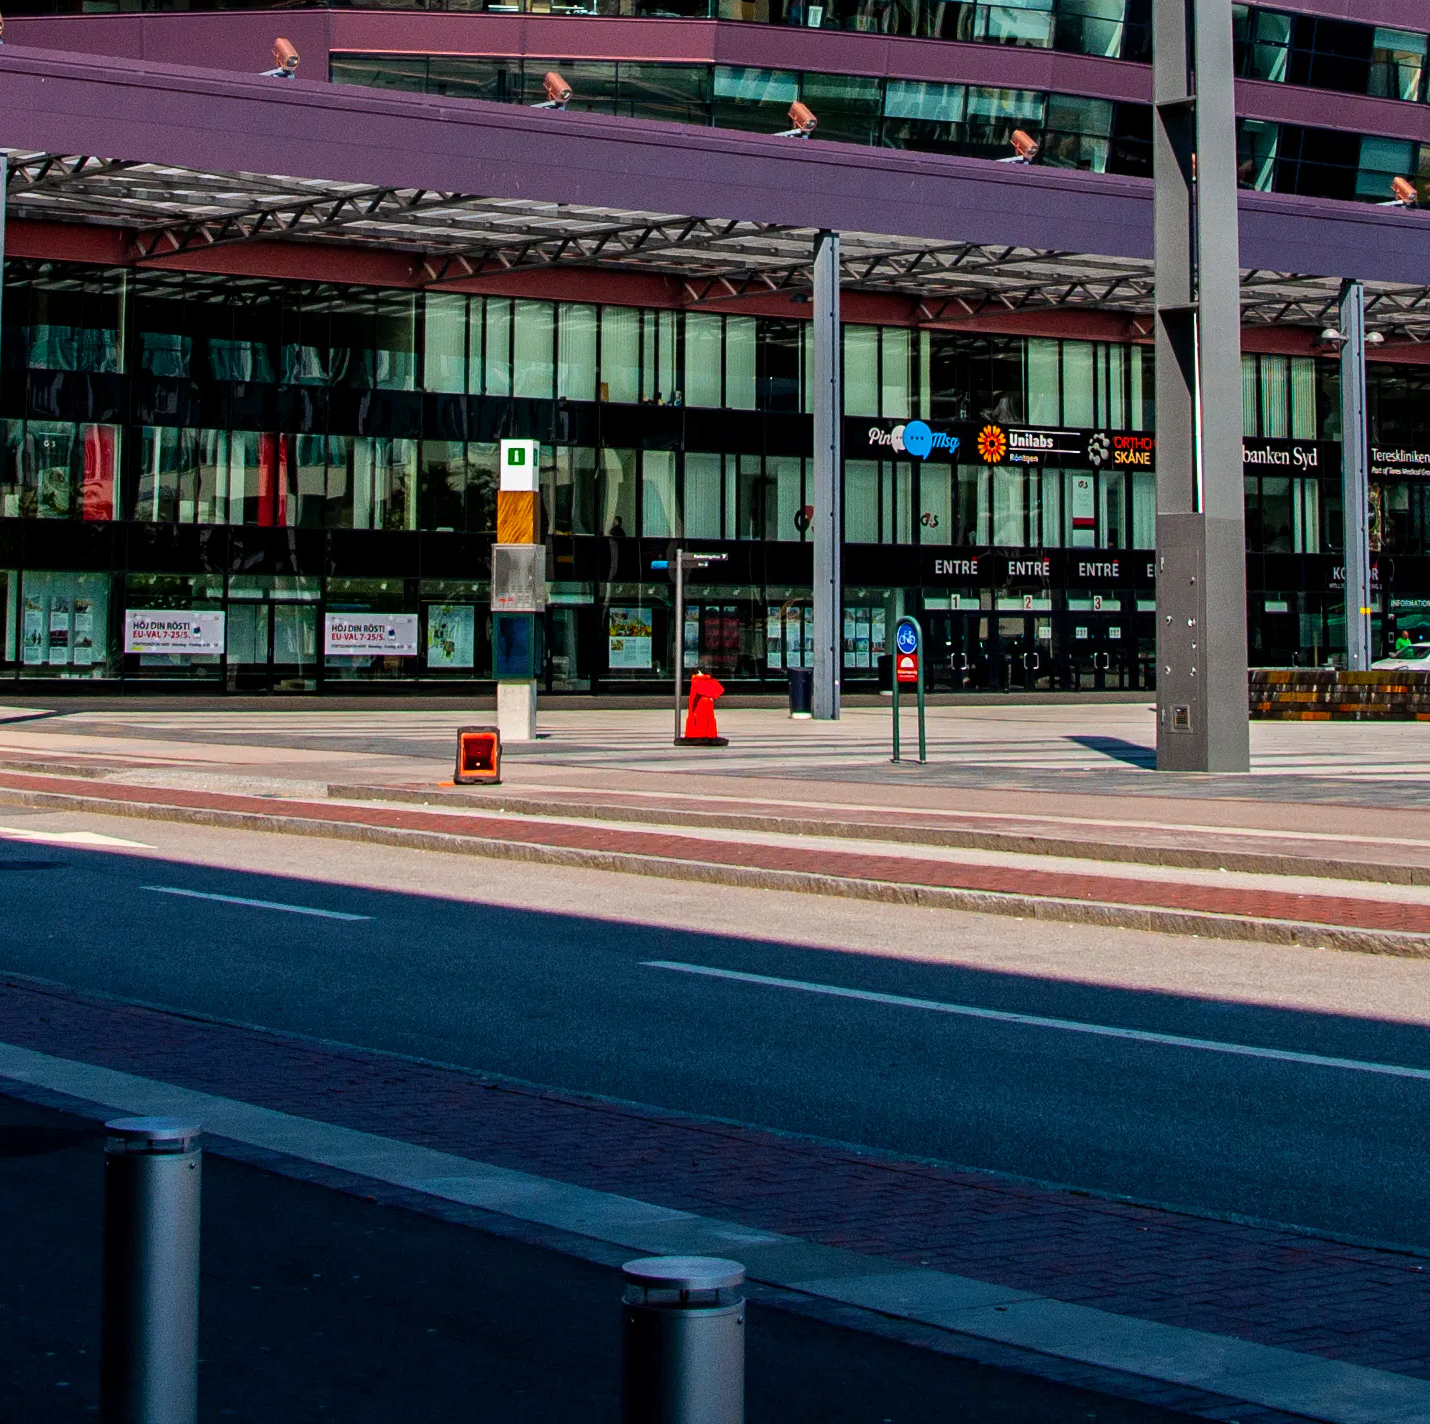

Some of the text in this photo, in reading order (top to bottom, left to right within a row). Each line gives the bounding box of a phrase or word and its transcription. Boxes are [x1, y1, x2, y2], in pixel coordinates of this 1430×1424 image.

[868, 427, 961, 454] Pin Msg
[1009, 433, 1054, 449] Unilabs
[1114, 436, 1153, 451] ORTHO
[1114, 449, 1152, 465] SKÅNE
[1293, 446, 1318, 470] Syd
[1371, 447, 1430, 464] Tereskliniken
[952, 595, 959, 608] 1
[1025, 596, 1032, 609] 2
[1095, 596, 1102, 610] 3
[133, 620, 149, 630] HÖJ
[151, 622, 165, 630] DIN
[332, 623, 347, 632] HÖJ
[348, 624, 361, 632] DIN
